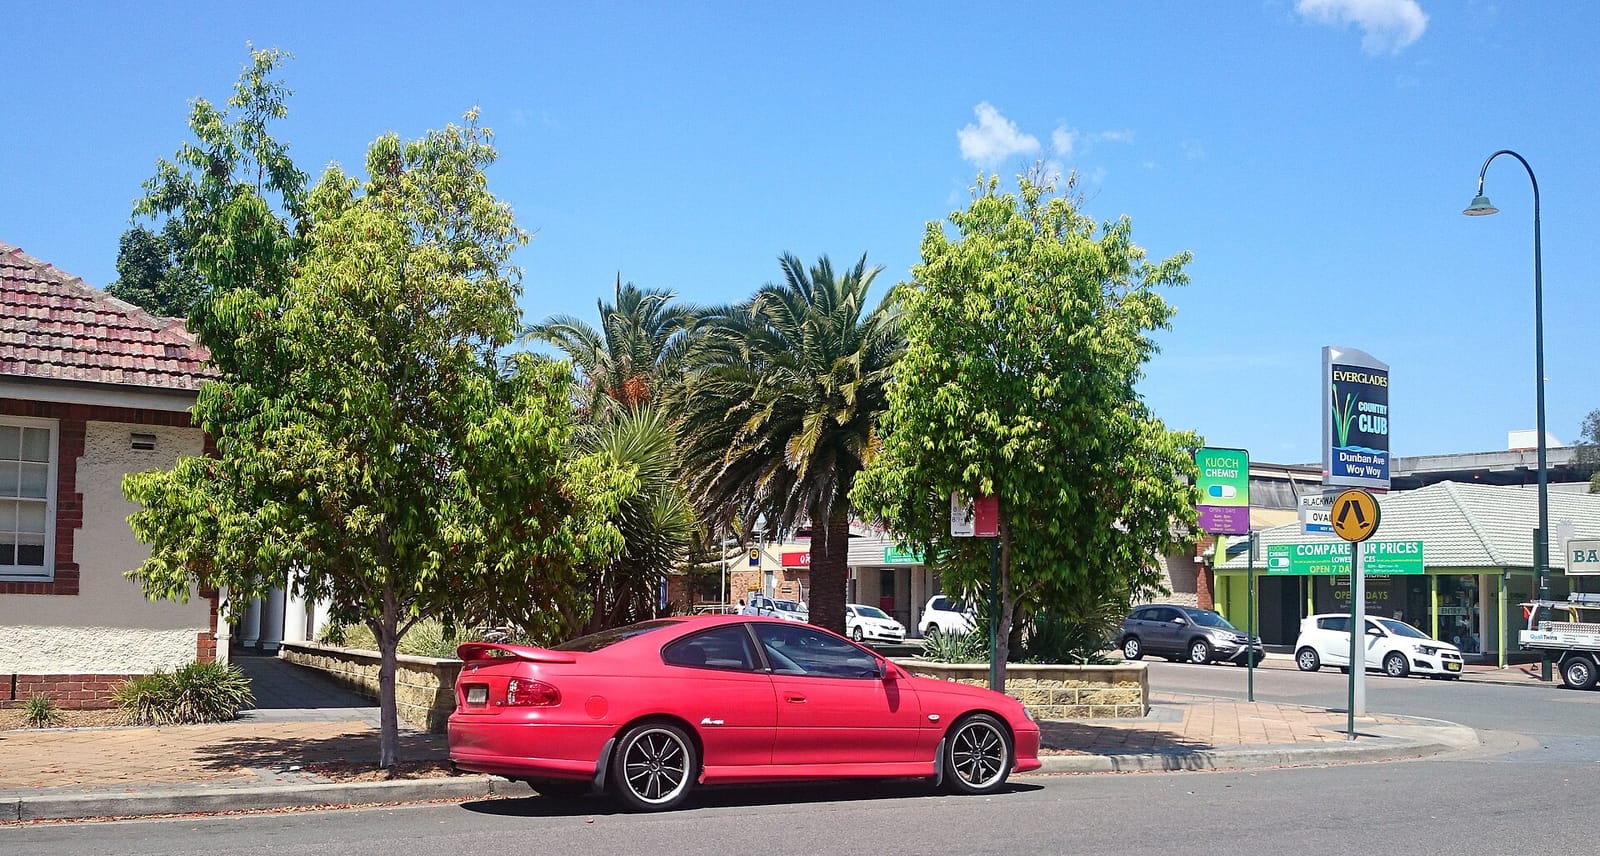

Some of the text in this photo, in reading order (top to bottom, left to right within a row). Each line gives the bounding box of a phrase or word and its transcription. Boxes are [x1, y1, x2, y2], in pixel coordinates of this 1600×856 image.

[1333, 371, 1388, 388] EVERGLADES
[1358, 401, 1388, 415] COUNTRY
[1358, 414, 1388, 435] CLUB
[1205, 457, 1239, 469] KUOCH
[1339, 452, 1385, 465] Dunban Ave
[1205, 468, 1239, 479] CHEMIST
[1346, 464, 1381, 478] Woy Woy
[1296, 542, 1419, 556] COMPARE UR PRICES
[1309, 564, 1351, 574] OPEN 7 DA
[1334, 590, 1389, 600] OPE DAYS
